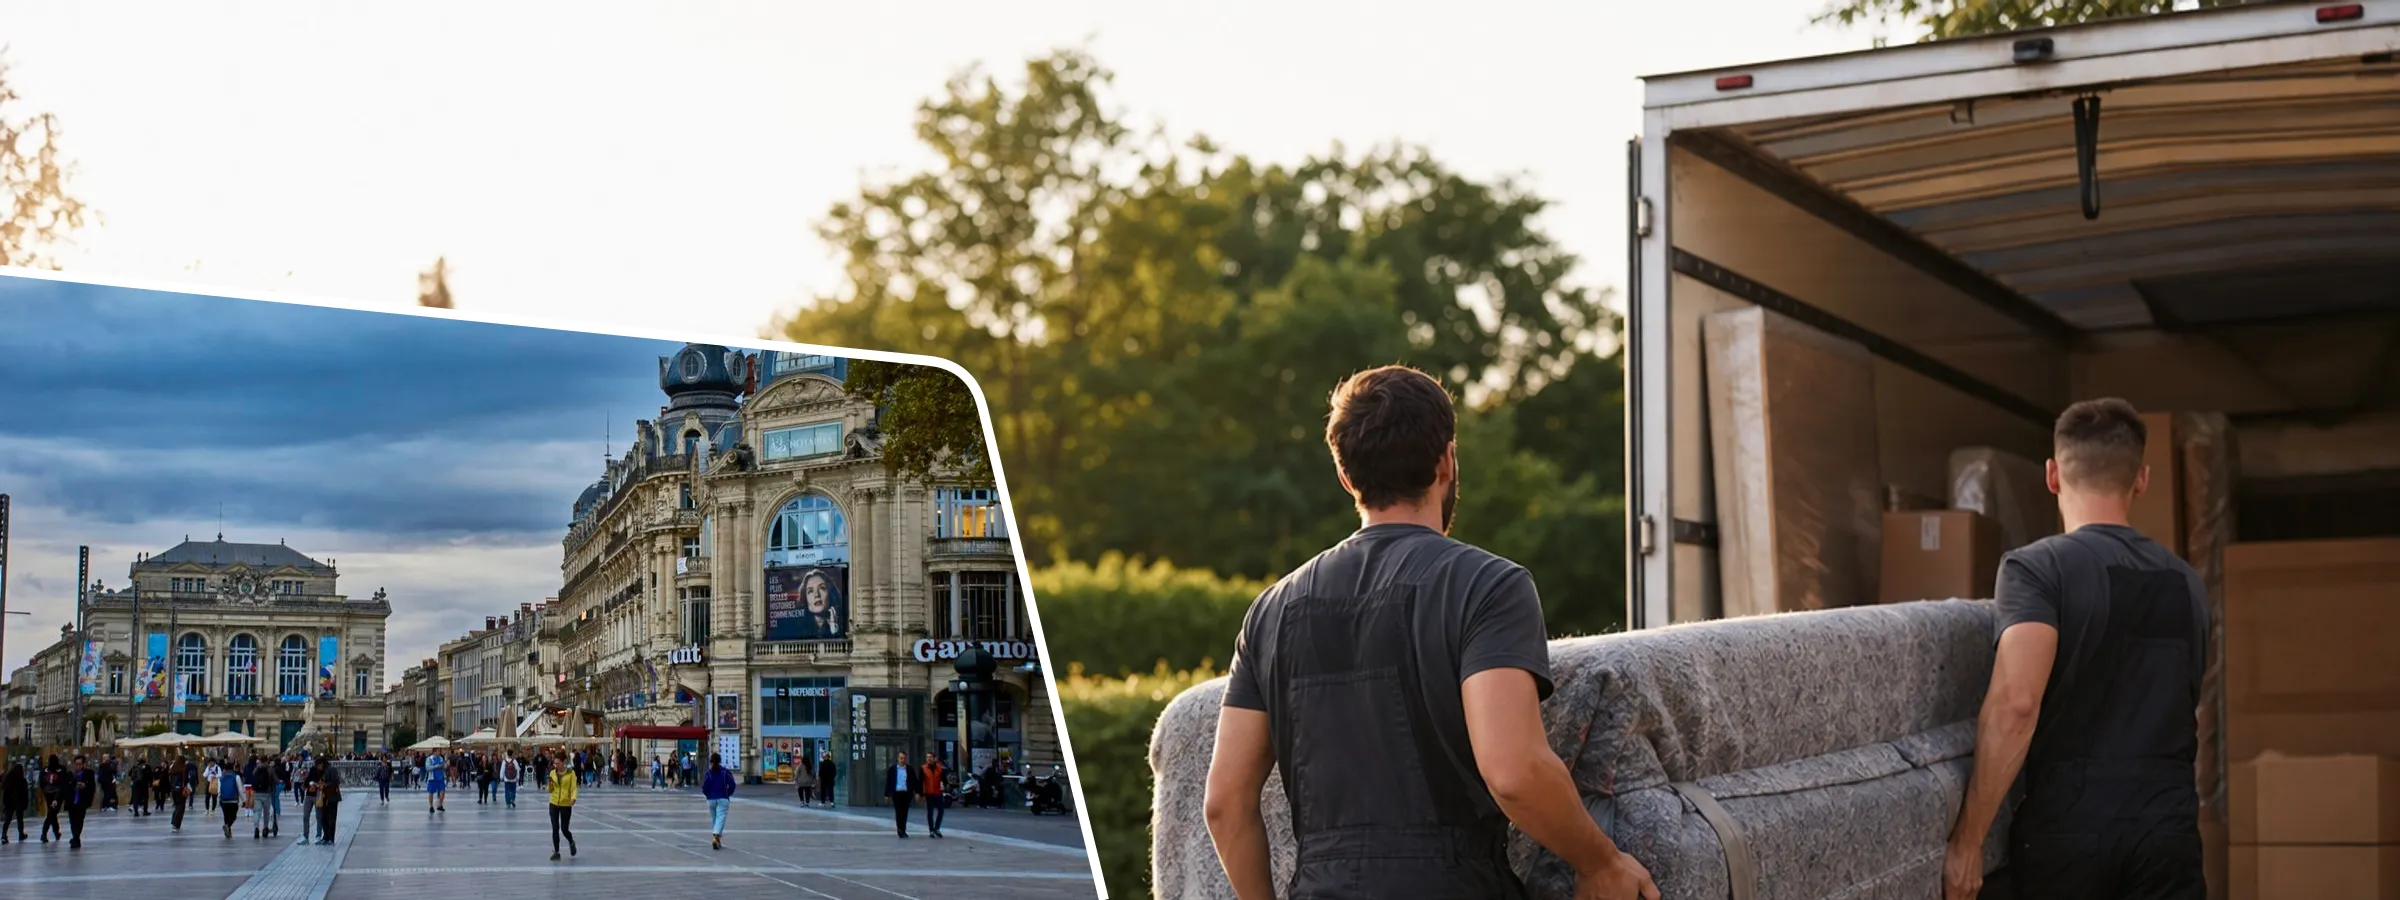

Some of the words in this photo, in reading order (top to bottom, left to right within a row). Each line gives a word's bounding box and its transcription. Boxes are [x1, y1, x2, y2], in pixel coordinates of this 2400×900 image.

[789, 435, 833, 449] NOTAIRES
[769, 576, 779, 584] LES
[769, 584, 783, 593] PLUS
[769, 593, 788, 601] BELLES
[769, 601, 796, 610] HISTOIRES
[769, 609, 805, 619] COMMENCENT
